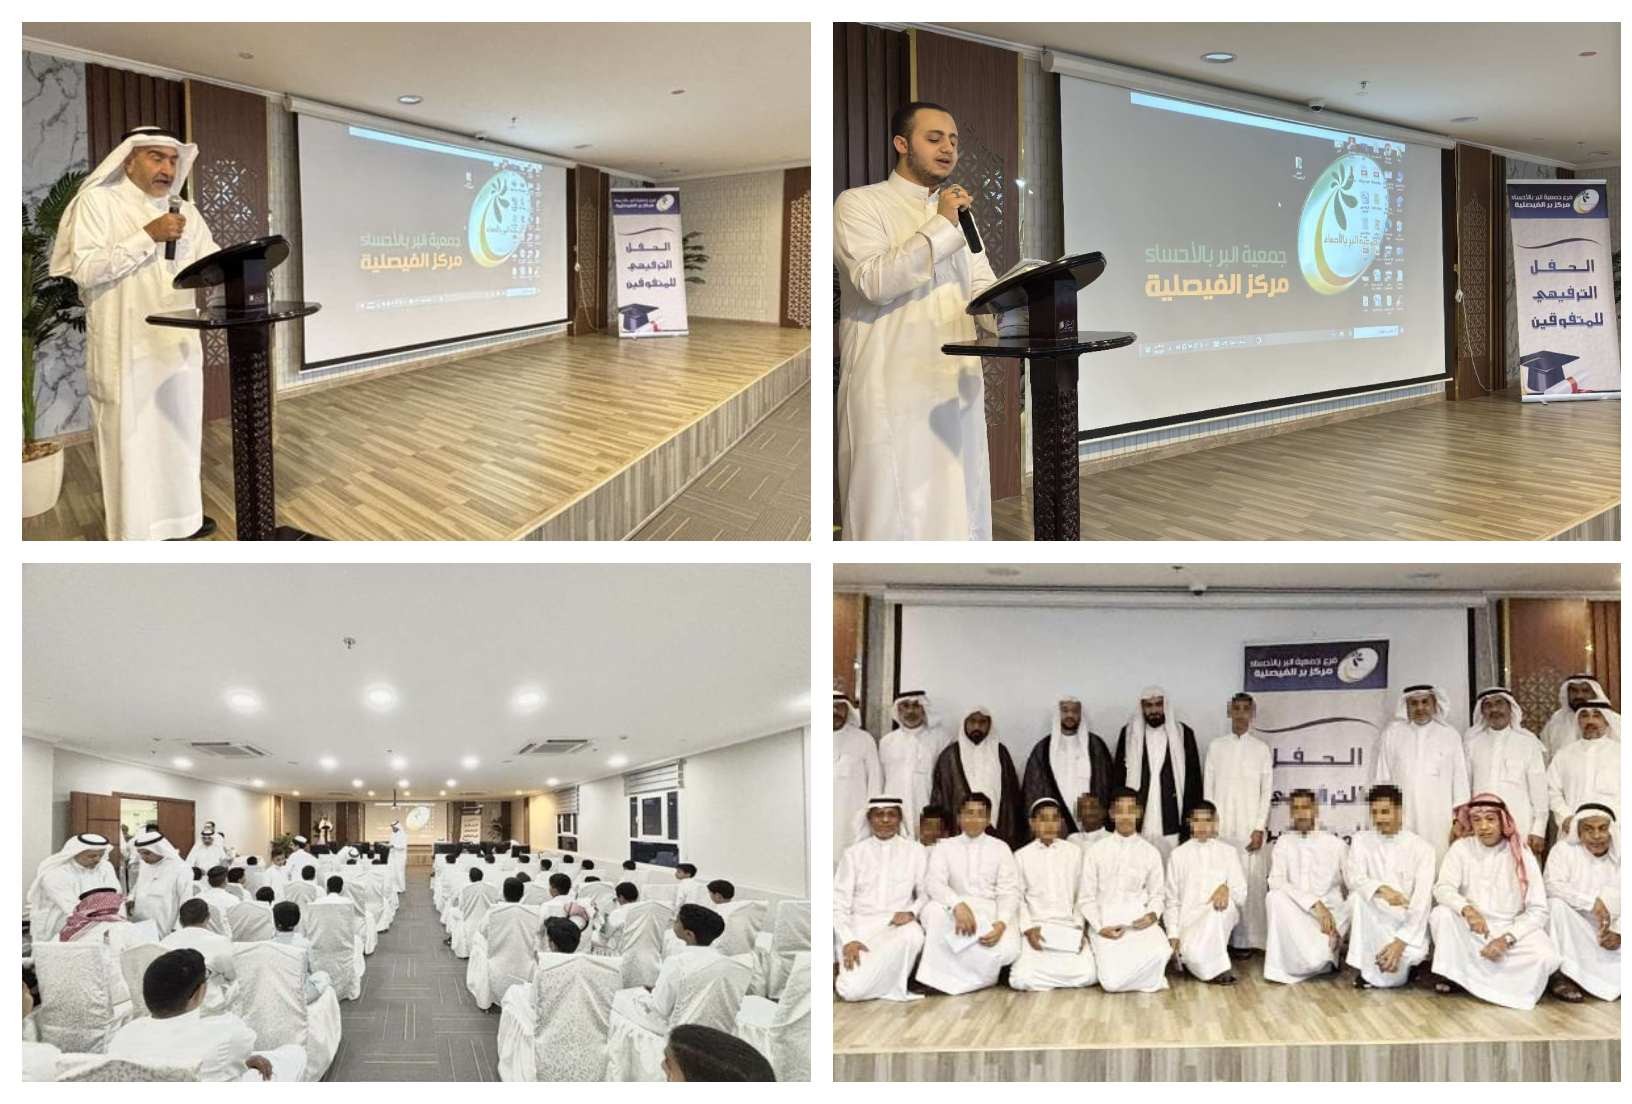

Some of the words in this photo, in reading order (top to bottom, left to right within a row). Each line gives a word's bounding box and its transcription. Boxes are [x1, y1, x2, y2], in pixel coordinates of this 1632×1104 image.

[626, 242, 671, 253] الحفل
[1145, 241, 1214, 268] بالأحساء
[1216, 245, 1240, 268] البر
[1242, 245, 1287, 269] جمعية
[361, 252, 429, 272] الفيصلية
[432, 252, 464, 270] مركز
[1530, 259, 1594, 275] الحفل
[626, 278, 676, 289] للمتفوقين
[1145, 273, 1241, 302] الفيصلية
[1245, 273, 1289, 298] مركز
[1532, 285, 1597, 303] الترفيهي
[1531, 312, 1603, 330] للمتفوقين
